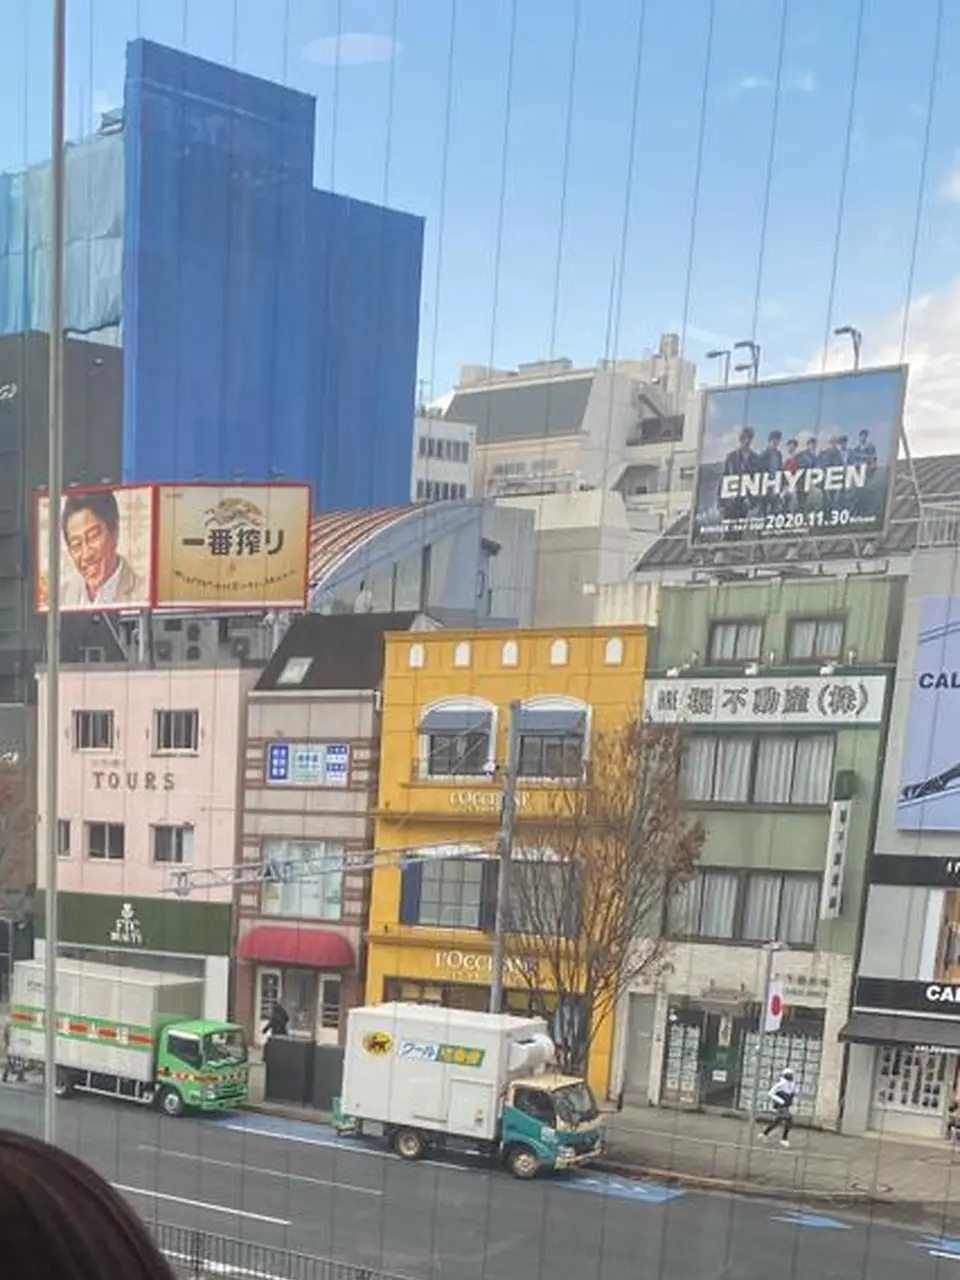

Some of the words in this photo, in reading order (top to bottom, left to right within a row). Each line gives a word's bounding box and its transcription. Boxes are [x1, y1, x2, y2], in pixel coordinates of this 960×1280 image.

[720, 464, 868, 499] ENHYPEN
[765, 509, 850, 529] 2020.11.30
[182, 528, 285, 556] 一番搾り
[918, 672, 960, 689] CAL
[93, 771, 175, 791] TOURS
